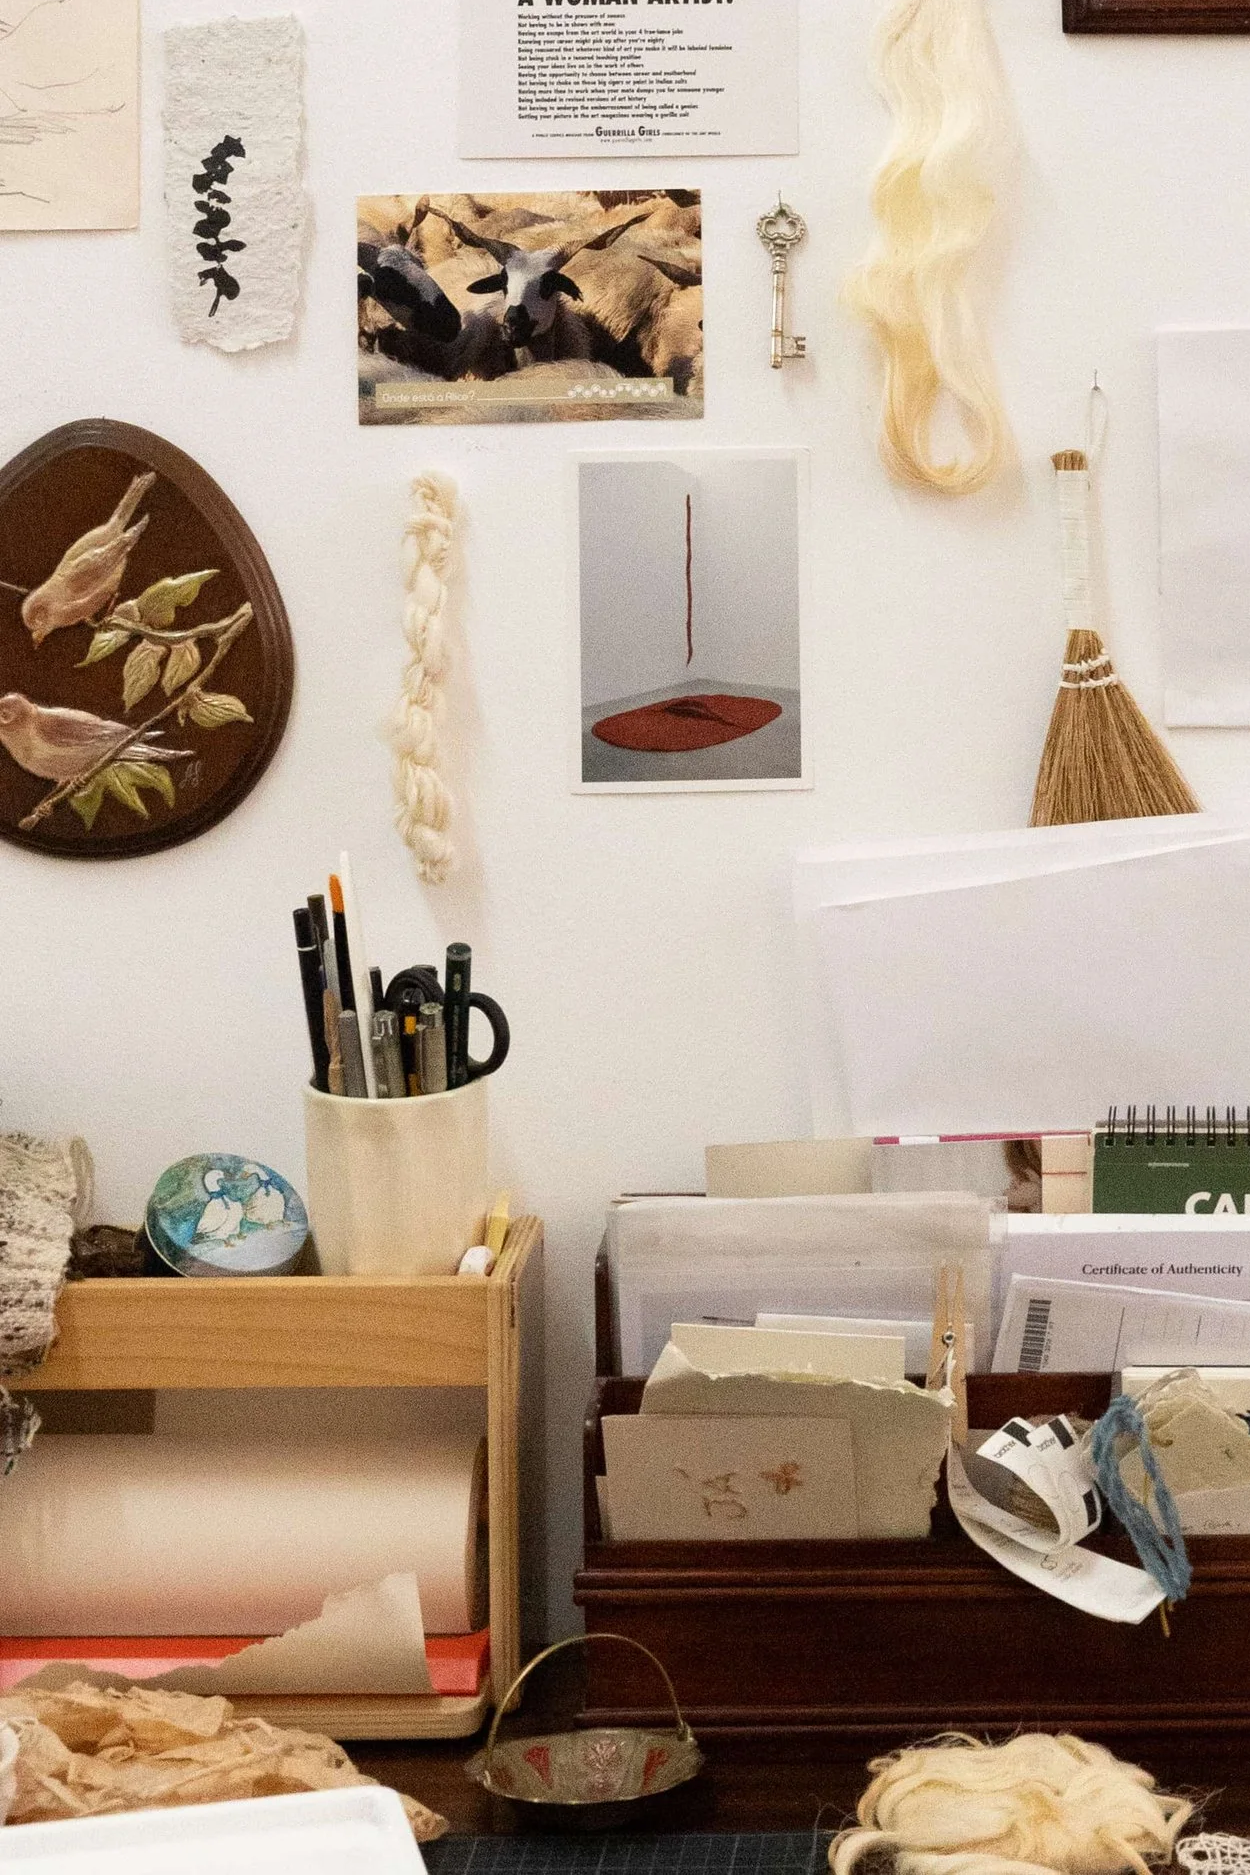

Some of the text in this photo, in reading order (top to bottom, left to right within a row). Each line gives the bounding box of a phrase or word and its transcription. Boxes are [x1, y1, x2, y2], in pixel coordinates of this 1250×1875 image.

[1082, 1263, 1244, 1277] Certificate of Authenticity
